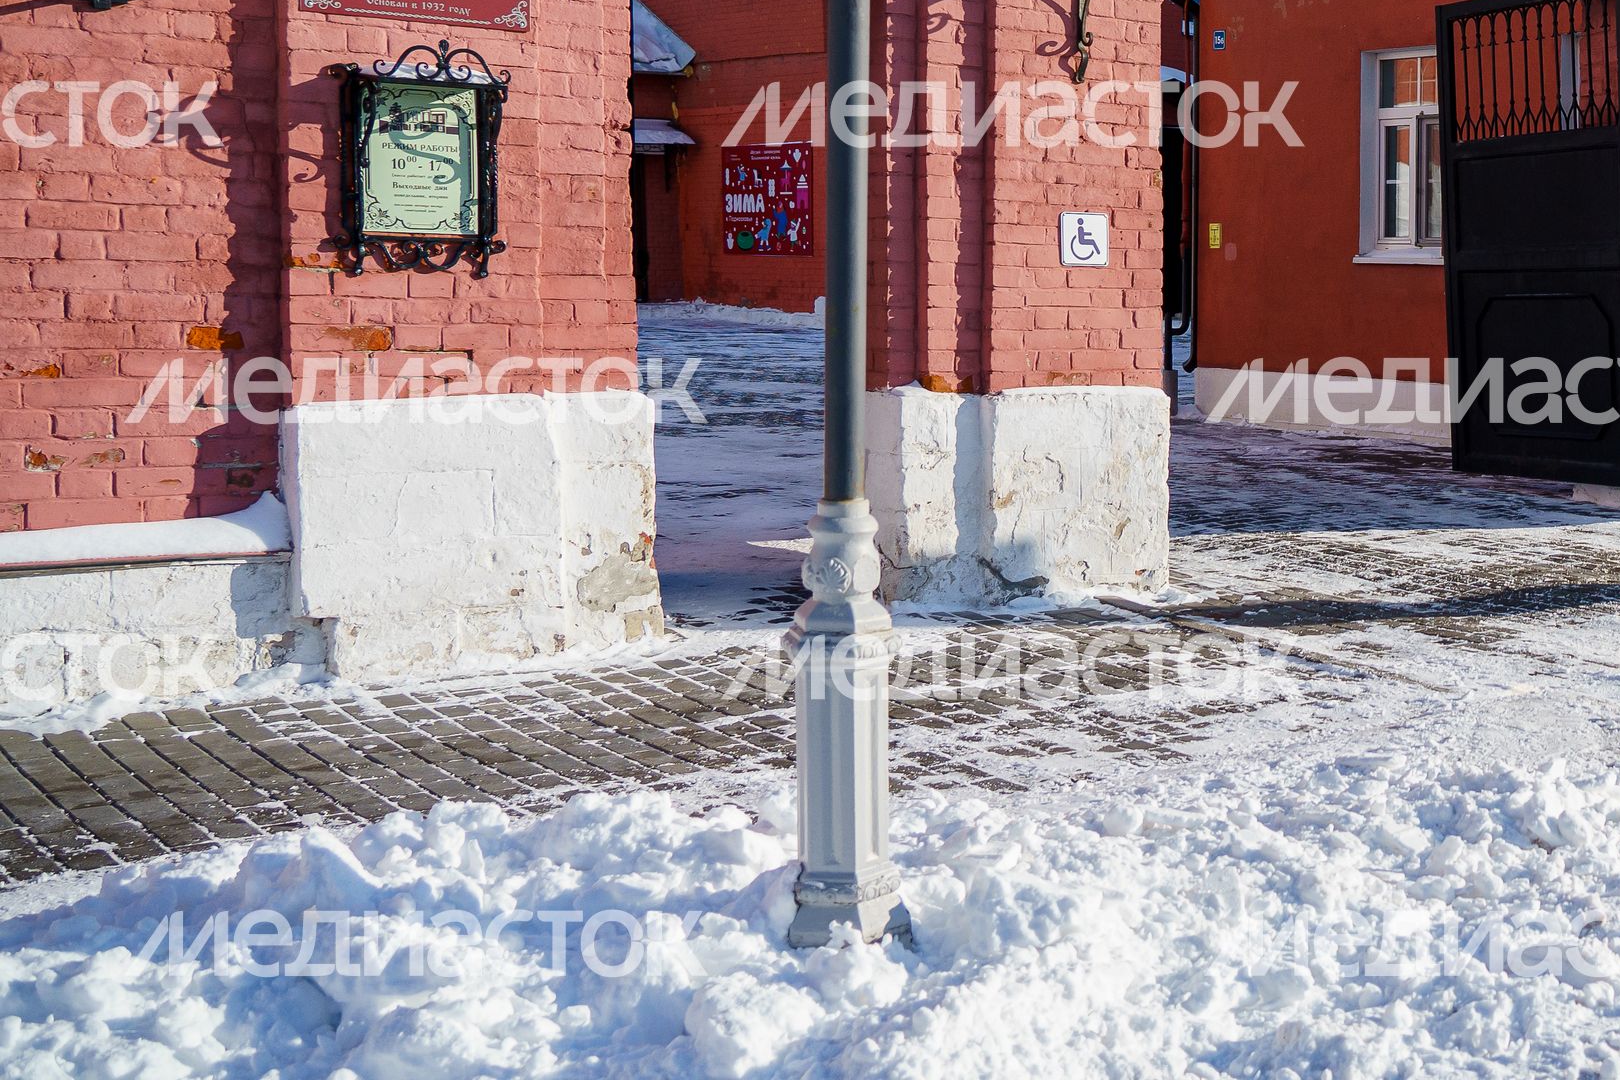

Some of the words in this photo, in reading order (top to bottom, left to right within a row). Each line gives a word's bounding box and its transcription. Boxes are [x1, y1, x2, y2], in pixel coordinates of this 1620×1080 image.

[422, 1, 445, 12] 1932
[449, 6, 471, 17] году
[382, 142, 417, 151] РЕЖИМ
[420, 144, 458, 153] РАБОТЫ
[392, 182, 431, 191] Выходные
[725, 193, 766, 213] ЗИМА
